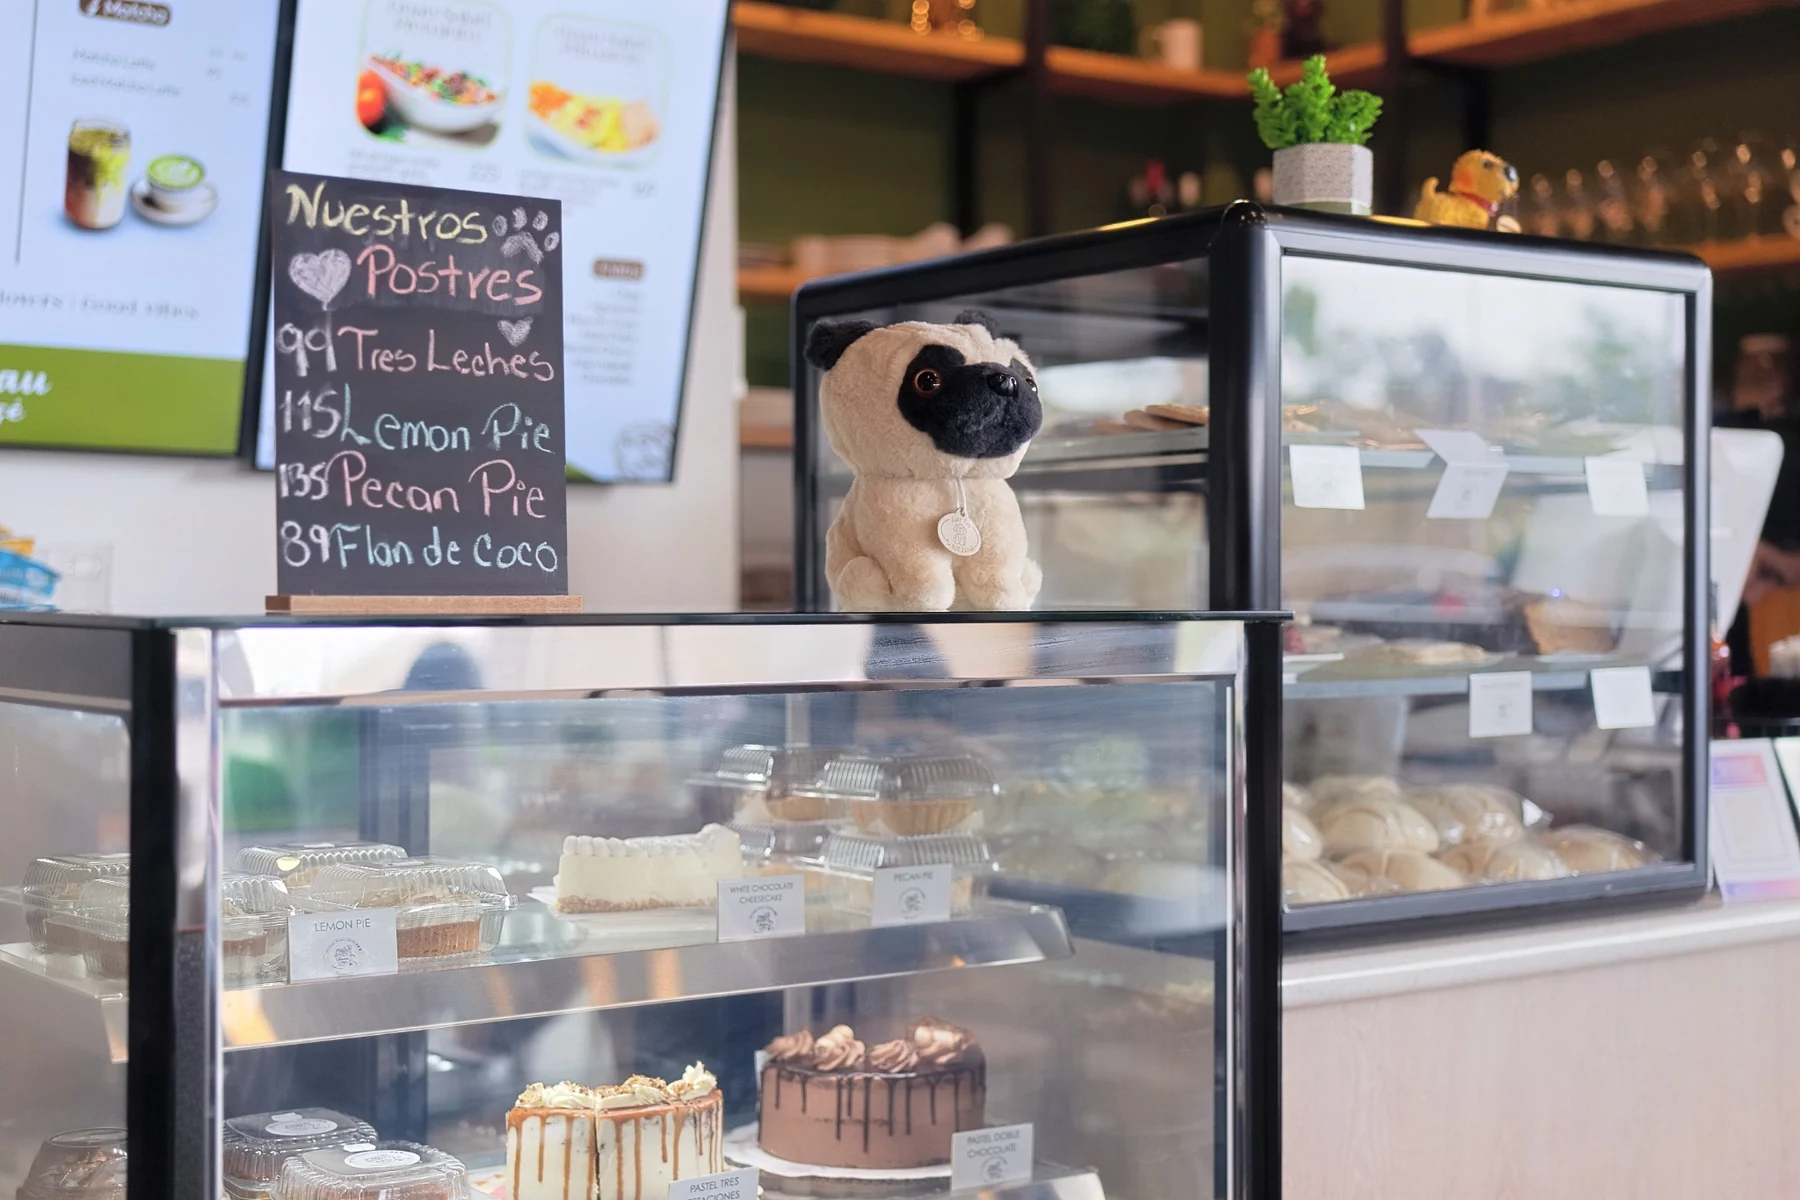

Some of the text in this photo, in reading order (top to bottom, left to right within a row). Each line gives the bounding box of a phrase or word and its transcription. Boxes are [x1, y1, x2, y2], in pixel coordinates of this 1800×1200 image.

[286, 182, 488, 245] Nuestros
[357, 244, 543, 305] Postres
[337, 326, 417, 373] Tres
[427, 329, 554, 382] Leches
[340, 383, 470, 452] Lemon
[481, 402, 555, 454] Pie
[278, 450, 546, 518] 135 Pecan Pie
[280, 520, 330, 567] 89
[329, 523, 415, 569] Flan
[423, 525, 461, 567] de
[894, 870, 933, 881] PECAN PIE
[729, 881, 795, 893] WHITE CHOCOLATE
[739, 893, 783, 904] CHEESECAKE
[315, 918, 371, 932] LEMON PIE
[966, 1129, 1021, 1145] PASTEL DOBLE
[967, 1142, 1017, 1158] CHOCOLATE
[689, 1176, 740, 1194] PASTEL TRES
